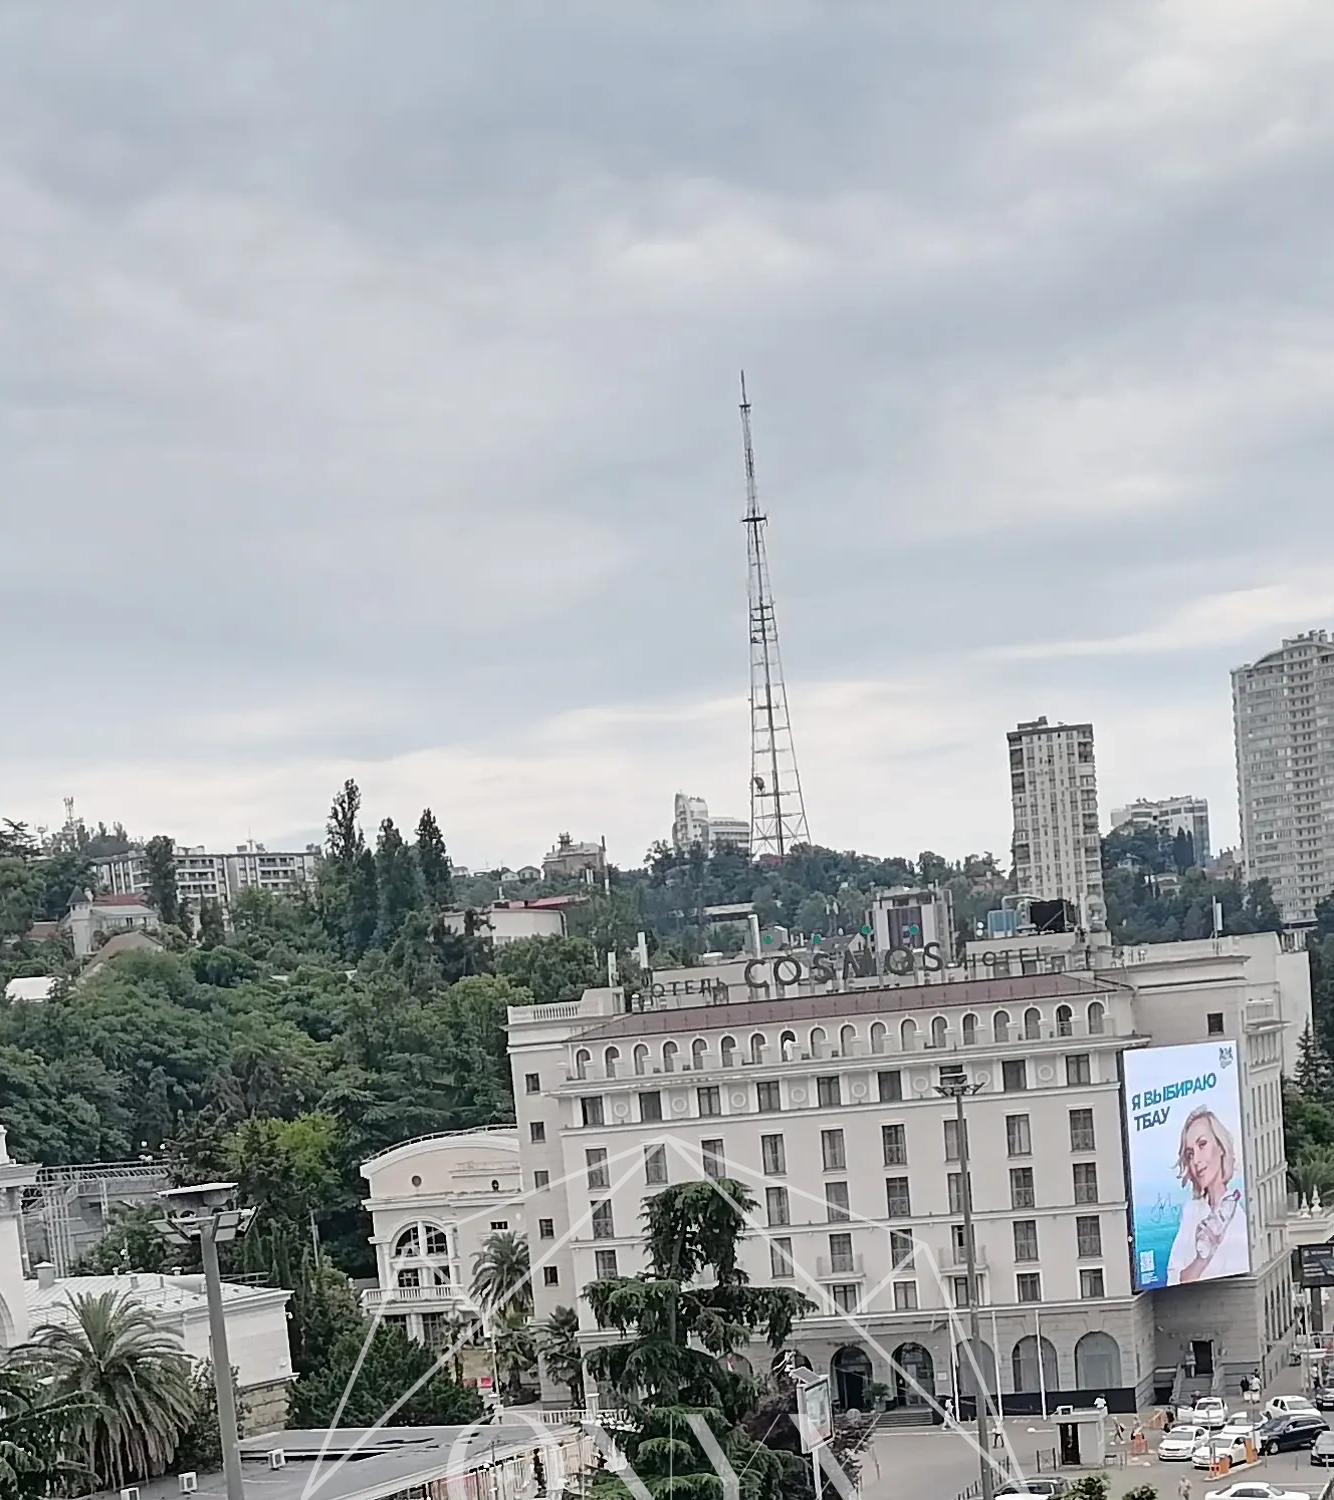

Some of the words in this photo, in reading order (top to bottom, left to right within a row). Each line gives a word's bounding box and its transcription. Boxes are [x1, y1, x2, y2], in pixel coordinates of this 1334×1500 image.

[744, 942, 944, 988] COSMOS
[963, 946, 1046, 970] HOTEL
[1131, 1091, 1141, 1112] Я
[1143, 1072, 1217, 1108] ВЫБИРАЮ
[1134, 1106, 1171, 1132] ТБАУ
